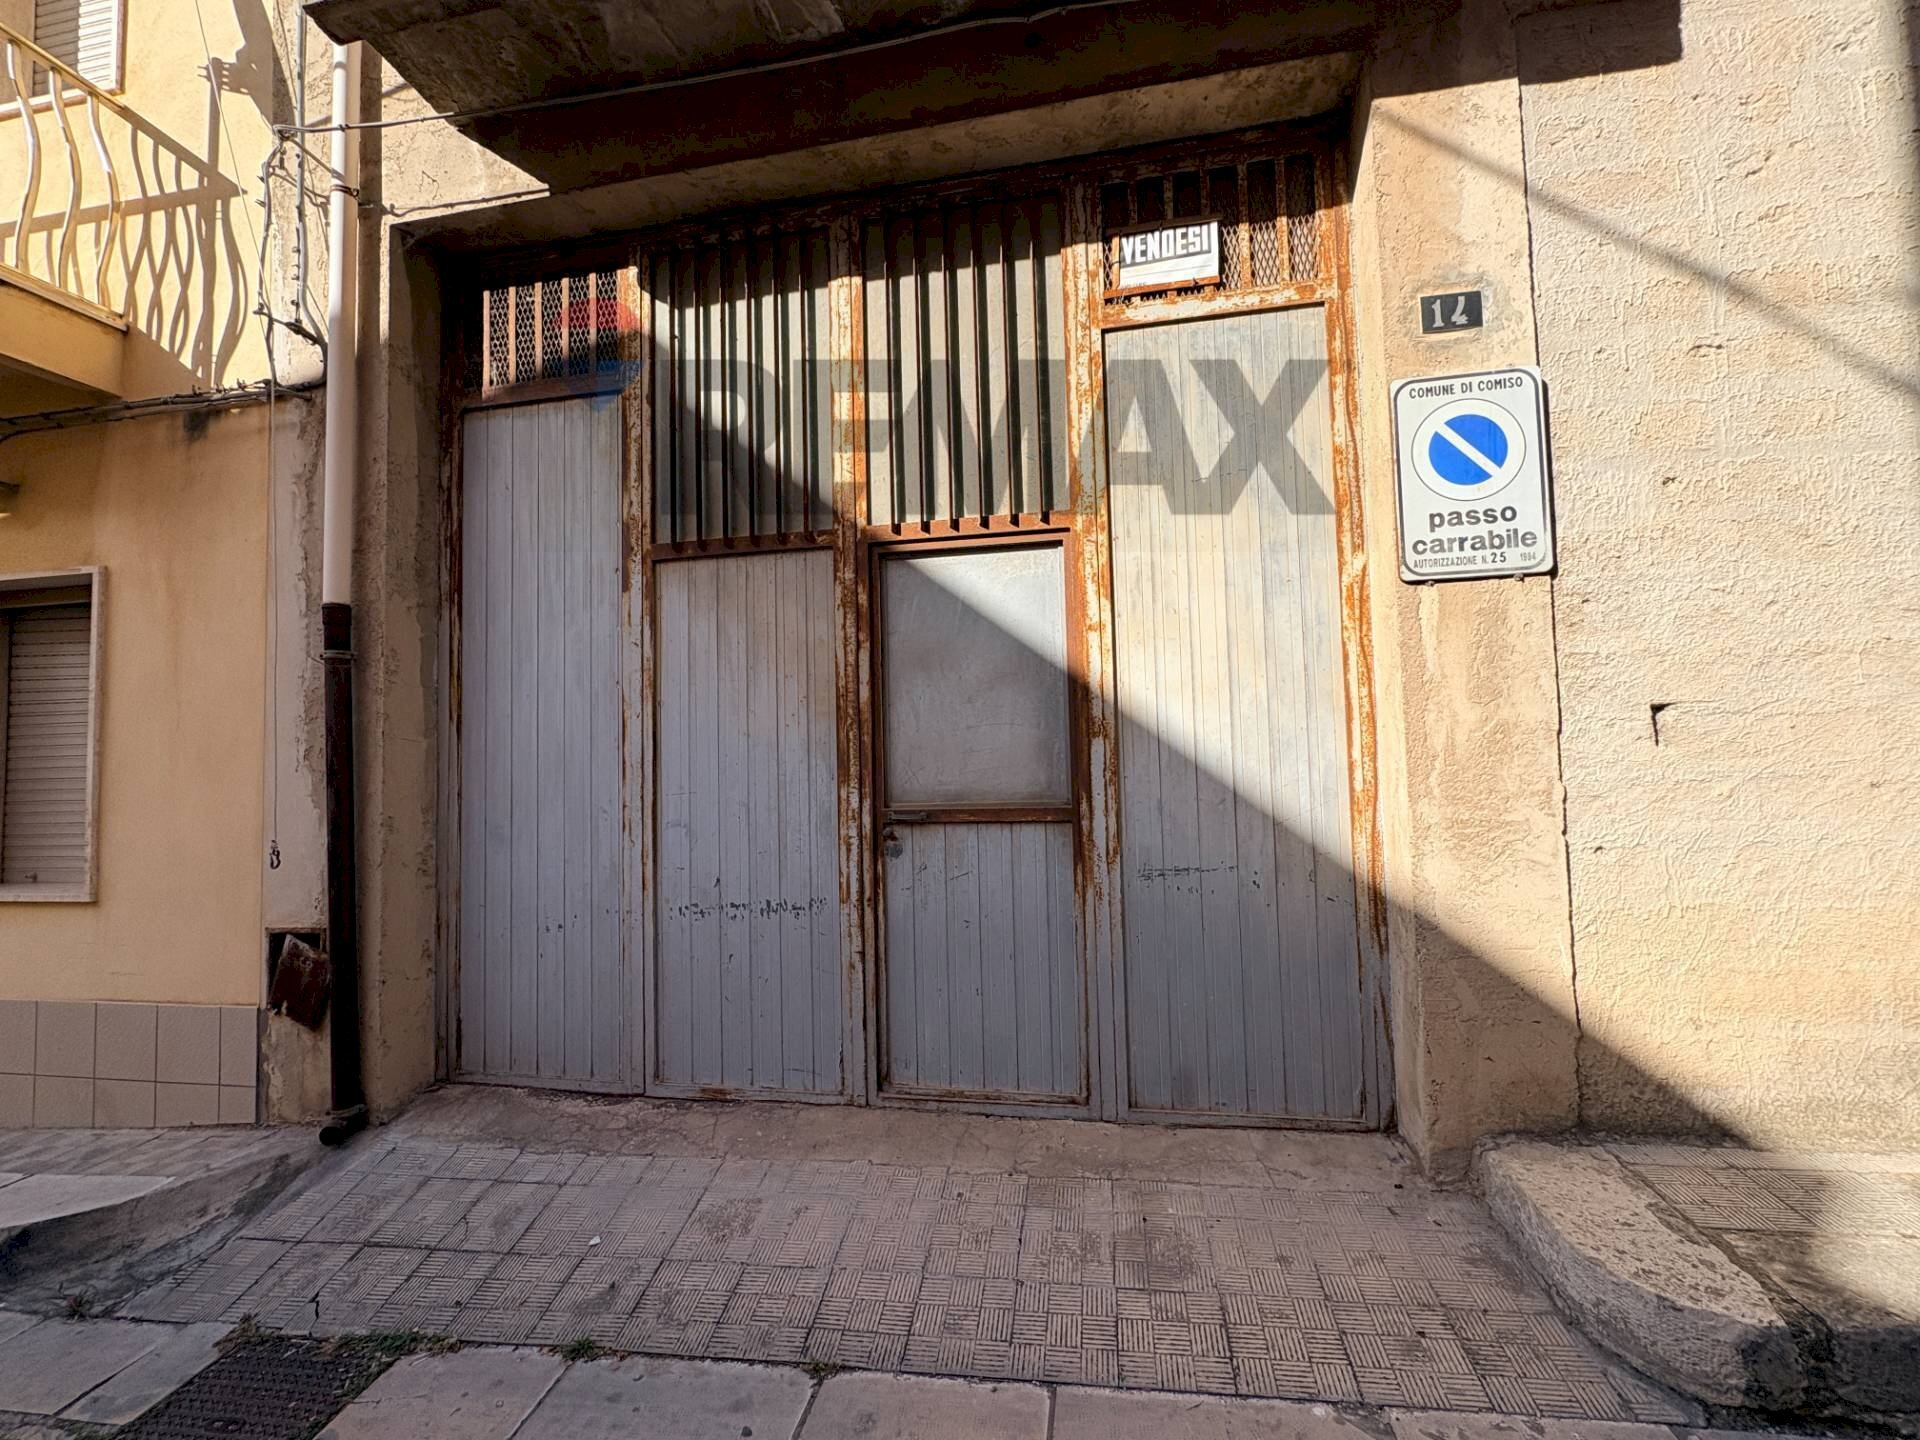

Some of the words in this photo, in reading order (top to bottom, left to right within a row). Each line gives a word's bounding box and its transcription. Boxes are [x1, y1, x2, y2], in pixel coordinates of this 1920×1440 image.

[1121, 223, 1210, 265] VENDESI
[1431, 296, 1469, 328] 14
[1409, 384, 1456, 399] COMUNE
[1461, 381, 1473, 393] DI
[1478, 377, 1523, 392] COMISO
[1429, 505, 1517, 533] passo
[1412, 528, 1538, 555] carrabile
[1414, 555, 1477, 569] AUTORIZZAZIONE
[1490, 552, 1507, 564] 25
